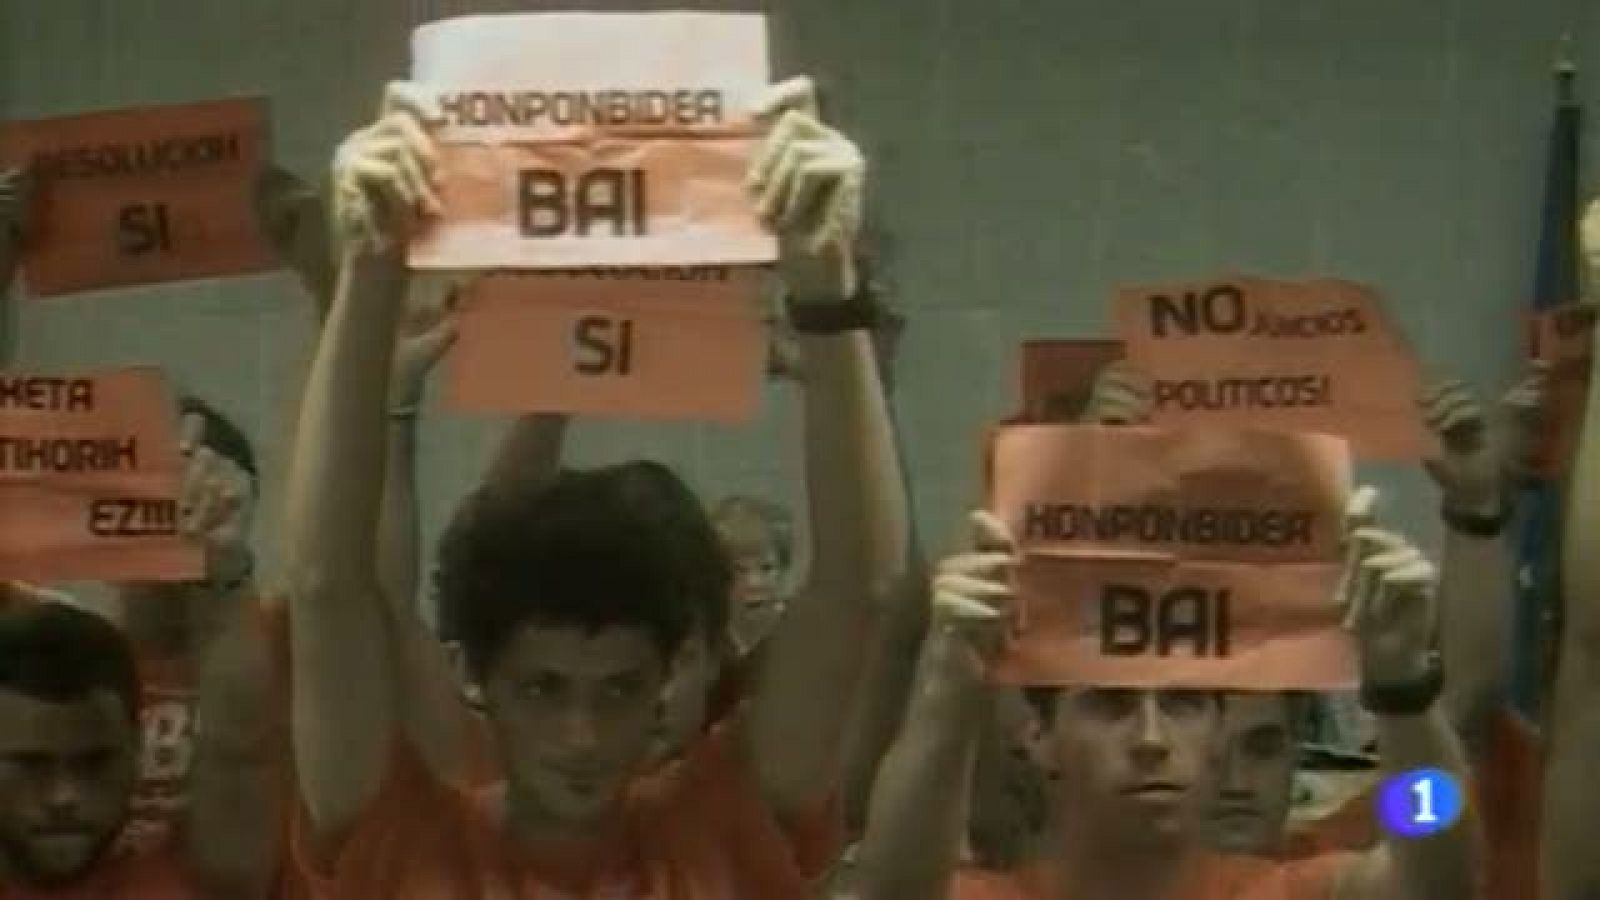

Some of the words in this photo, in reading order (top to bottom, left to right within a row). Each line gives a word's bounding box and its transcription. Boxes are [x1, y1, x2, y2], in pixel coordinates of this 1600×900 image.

[119, 203, 171, 252] SI
[518, 168, 648, 237] BAI
[1150, 284, 1246, 337] NO
[574, 316, 633, 377] SI
[1101, 583, 1232, 657] BAI
